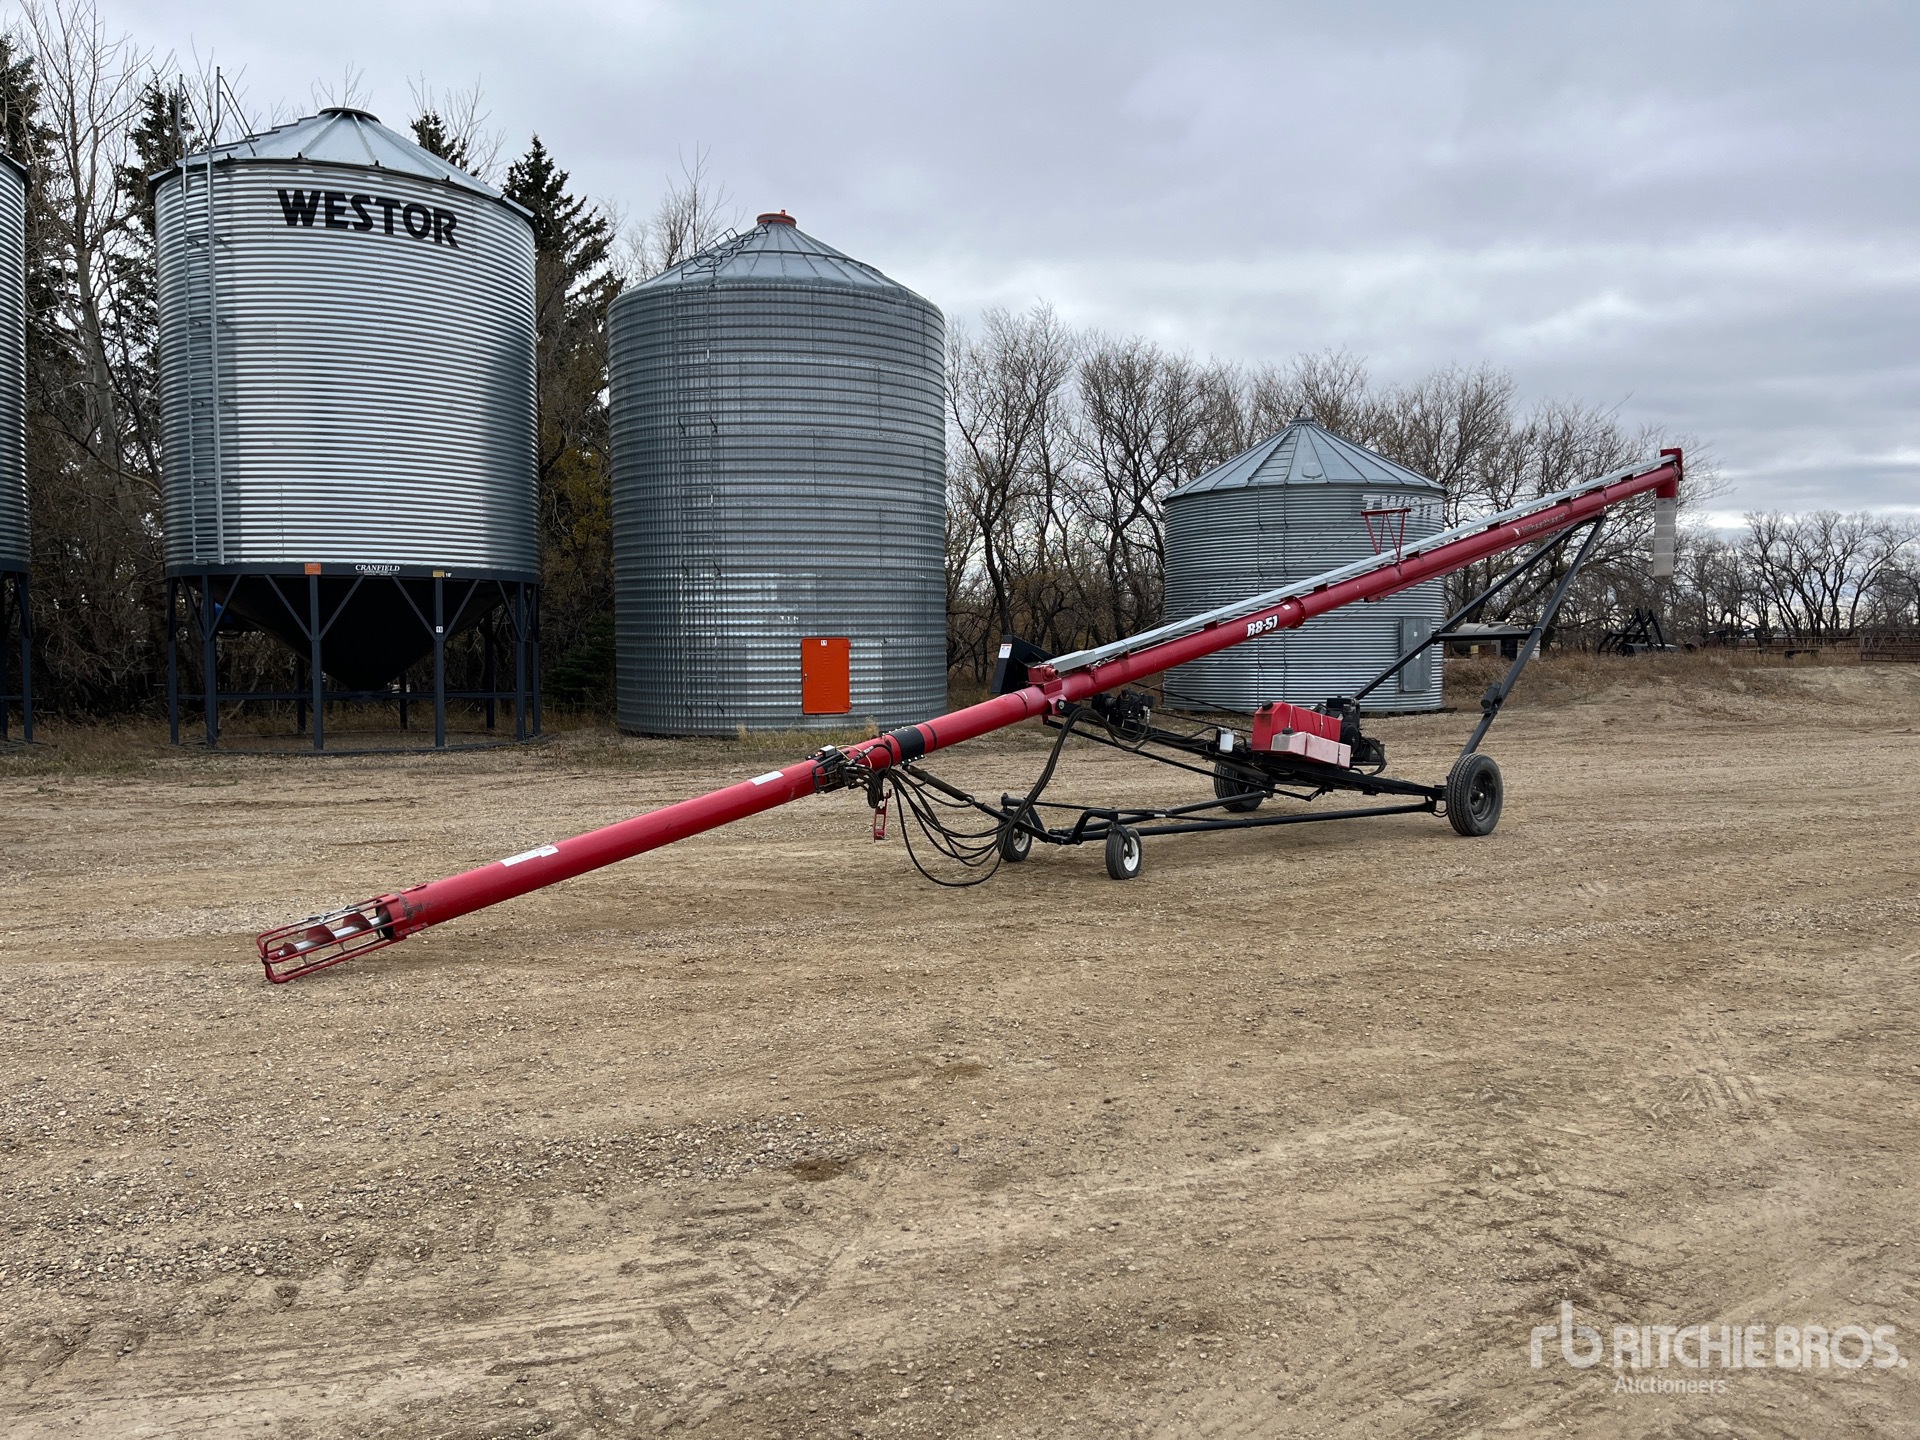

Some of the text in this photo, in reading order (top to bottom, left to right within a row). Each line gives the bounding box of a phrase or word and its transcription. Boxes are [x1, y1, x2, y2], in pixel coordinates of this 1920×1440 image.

[277, 189, 460, 249] WESTOR
[355, 564, 400, 572] CRANFIELD
[1246, 614, 1279, 638] R8-51
